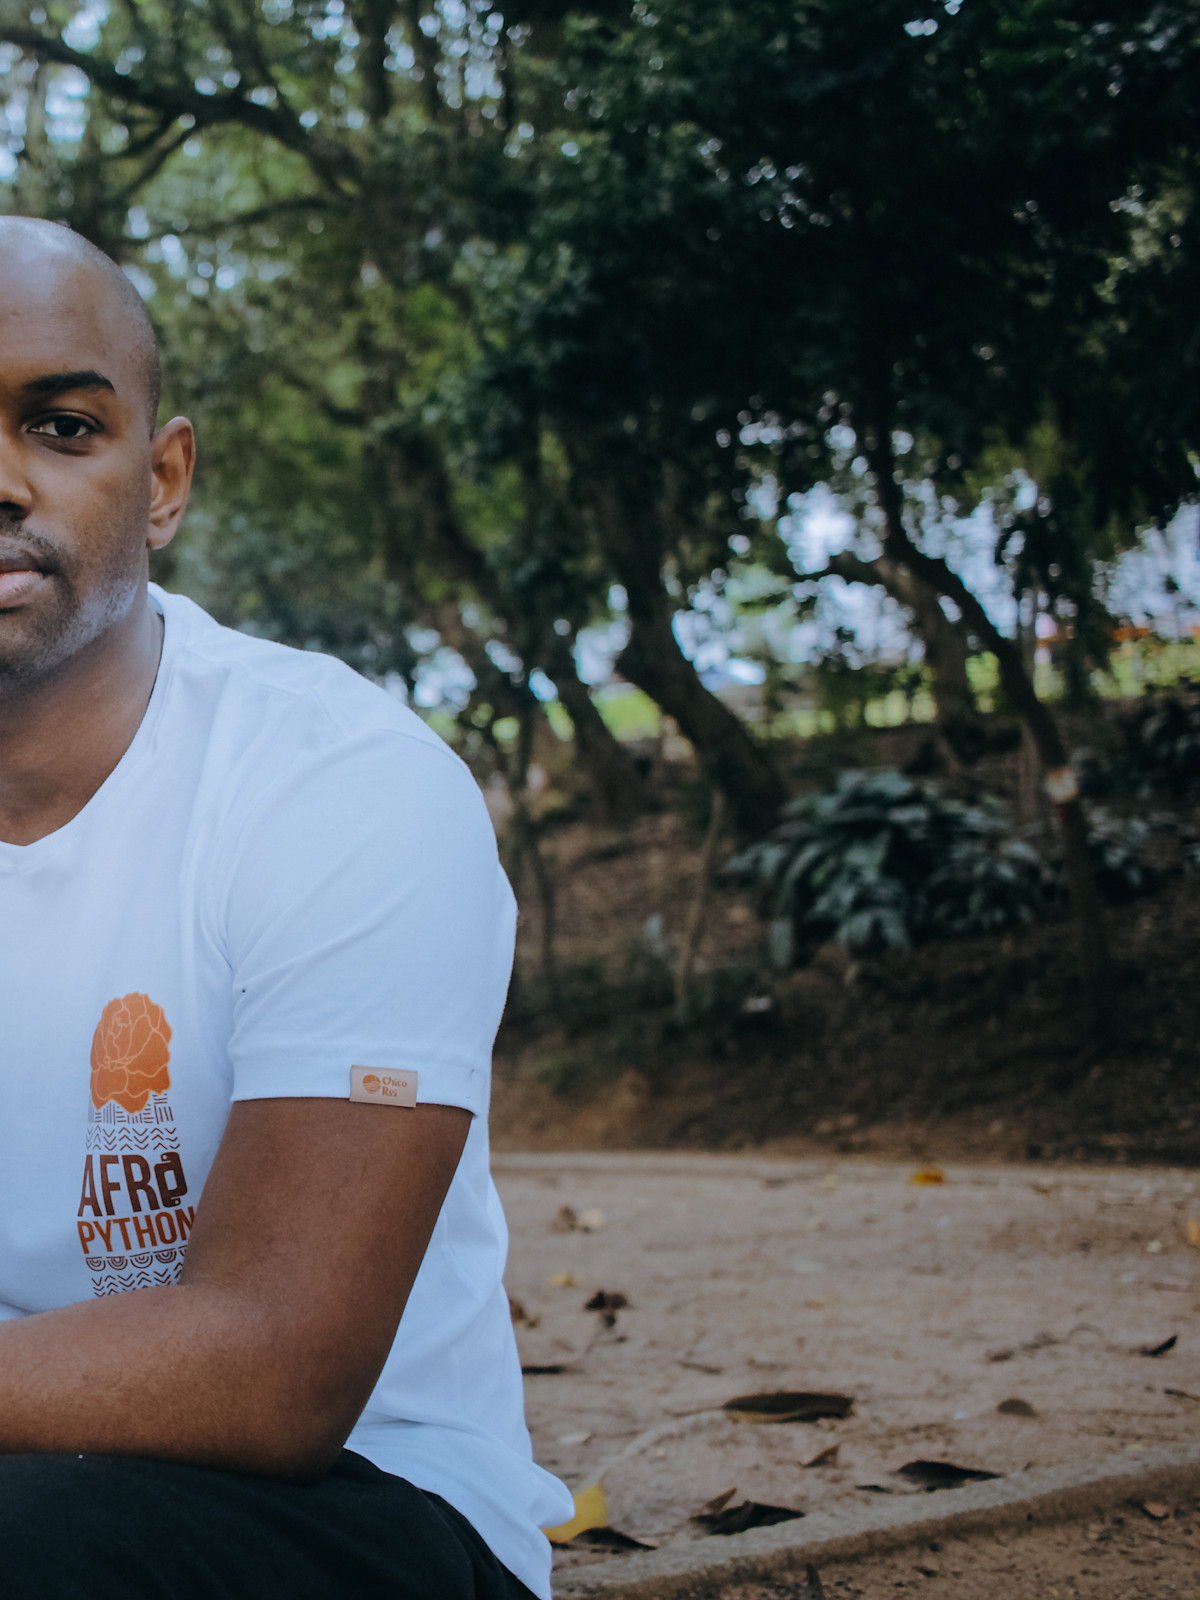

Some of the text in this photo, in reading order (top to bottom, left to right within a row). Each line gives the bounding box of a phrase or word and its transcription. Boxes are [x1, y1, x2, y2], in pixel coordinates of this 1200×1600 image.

[382, 1076, 407, 1088] Chico
[382, 1086, 397, 1097] Rei
[77, 1151, 188, 1217] AFRO
[77, 1206, 195, 1254] PYTHON
